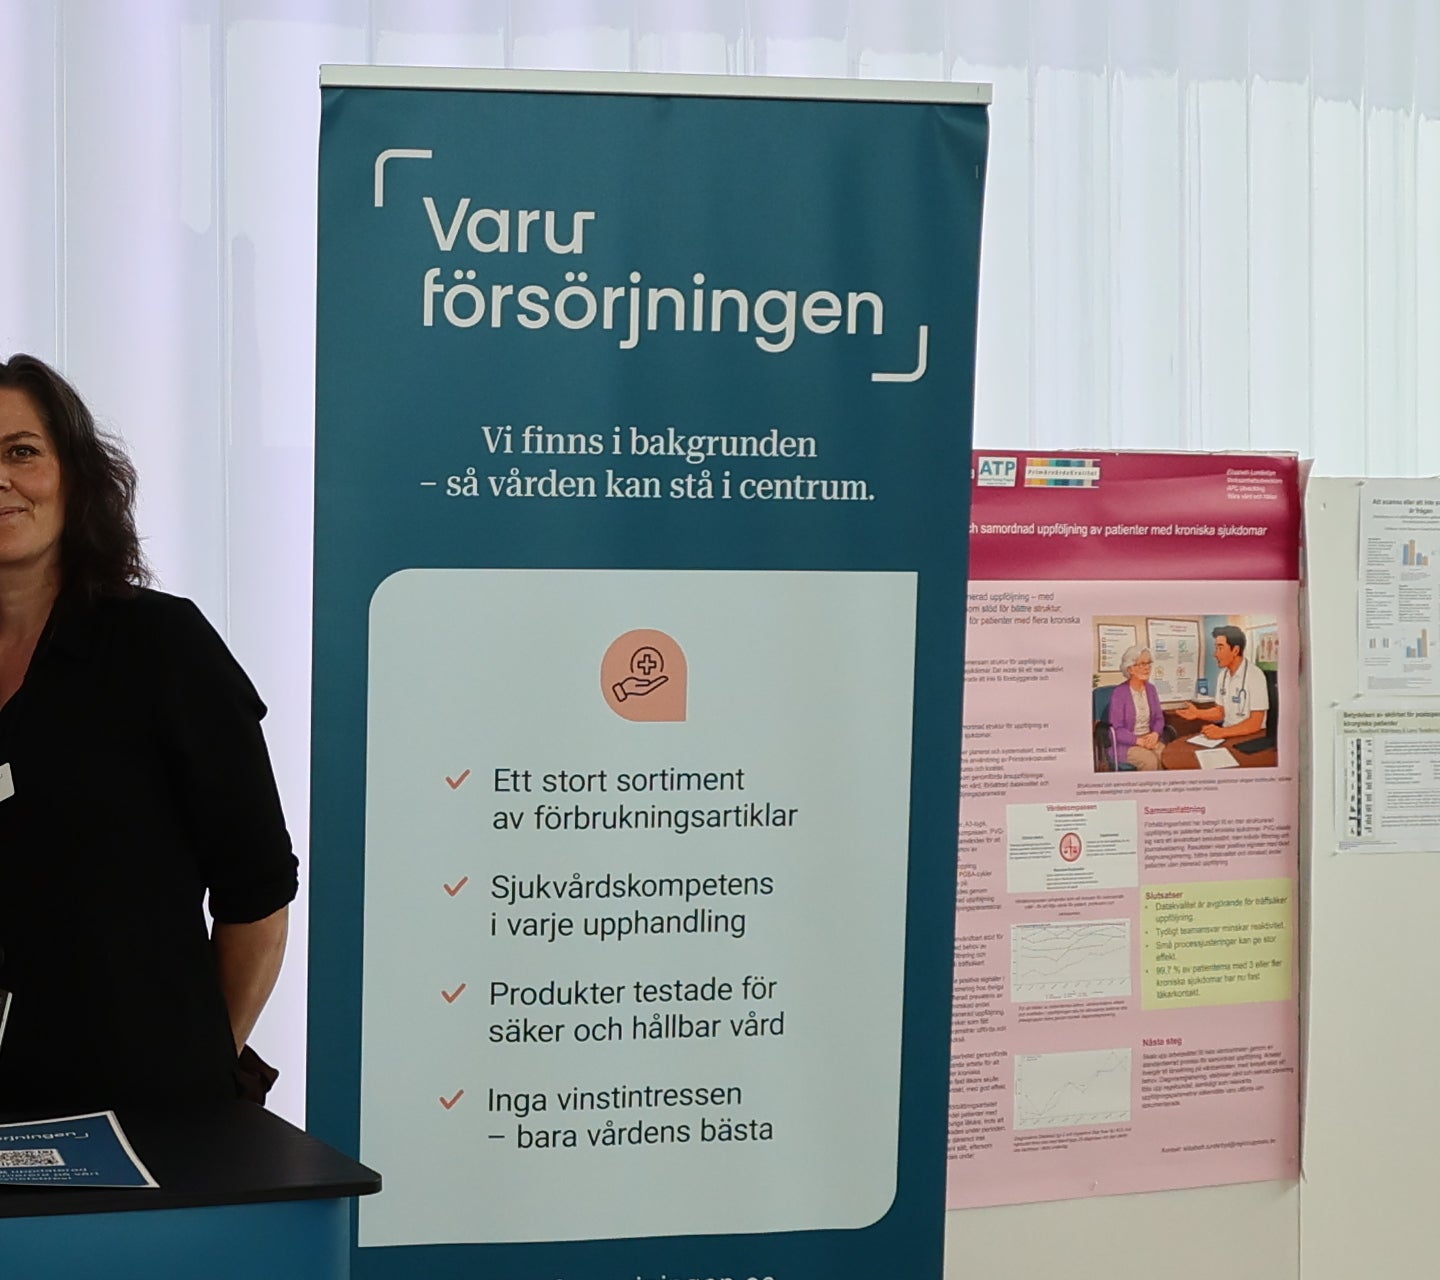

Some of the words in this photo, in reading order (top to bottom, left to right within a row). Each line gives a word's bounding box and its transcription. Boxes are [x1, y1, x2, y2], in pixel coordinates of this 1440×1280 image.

[422, 196, 596, 255] Varu
[423, 267, 884, 353] försörjningen
[482, 424, 514, 454] Vi
[522, 425, 604, 455] finns
[612, 426, 622, 455] i
[630, 426, 818, 465] bakgrunden
[447, 466, 480, 497] så
[488, 467, 597, 498] vården
[605, 468, 662, 498] kan
[670, 469, 714, 499] stå
[722, 470, 732, 499] i
[740, 474, 875, 501] centrum.
[980, 461, 1016, 476] ATP
[980, 523, 1035, 534] samordnad
[1037, 523, 1089, 537] uppföljning
[1090, 526, 1102, 534] av
[1105, 524, 1149, 537] patienter
[1151, 525, 1173, 535] med
[1175, 524, 1215, 535] kroniska
[1217, 525, 1267, 538] sjukdomar
[494, 769, 532, 793] Ett
[542, 769, 608, 793] stort
[616, 767, 745, 792] sortiment
[493, 811, 525, 830] av
[534, 803, 799, 835] förbrukningsartiklar
[491, 872, 774, 902] Sjukvårdskompetens
[491, 912, 497, 937] i
[507, 912, 574, 943] varje
[583, 908, 746, 942] upphandling
[490, 980, 626, 1006] Produkter
[633, 976, 733, 1003] testade
[742, 974, 778, 1000] för
[488, 1017, 566, 1043] säker
[573, 1016, 623, 1042] och
[632, 1012, 722, 1040] hållbar
[729, 1010, 785, 1037] vård
[1142, 1038, 1164, 1047] Nästa
[1166, 1037, 1183, 1046] steg
[488, 1087, 547, 1115] Inga
[557, 1084, 742, 1111] vinstintressen
[516, 1121, 577, 1149] bara
[587, 1119, 691, 1147] vårdens
[700, 1117, 773, 1143] bästa
